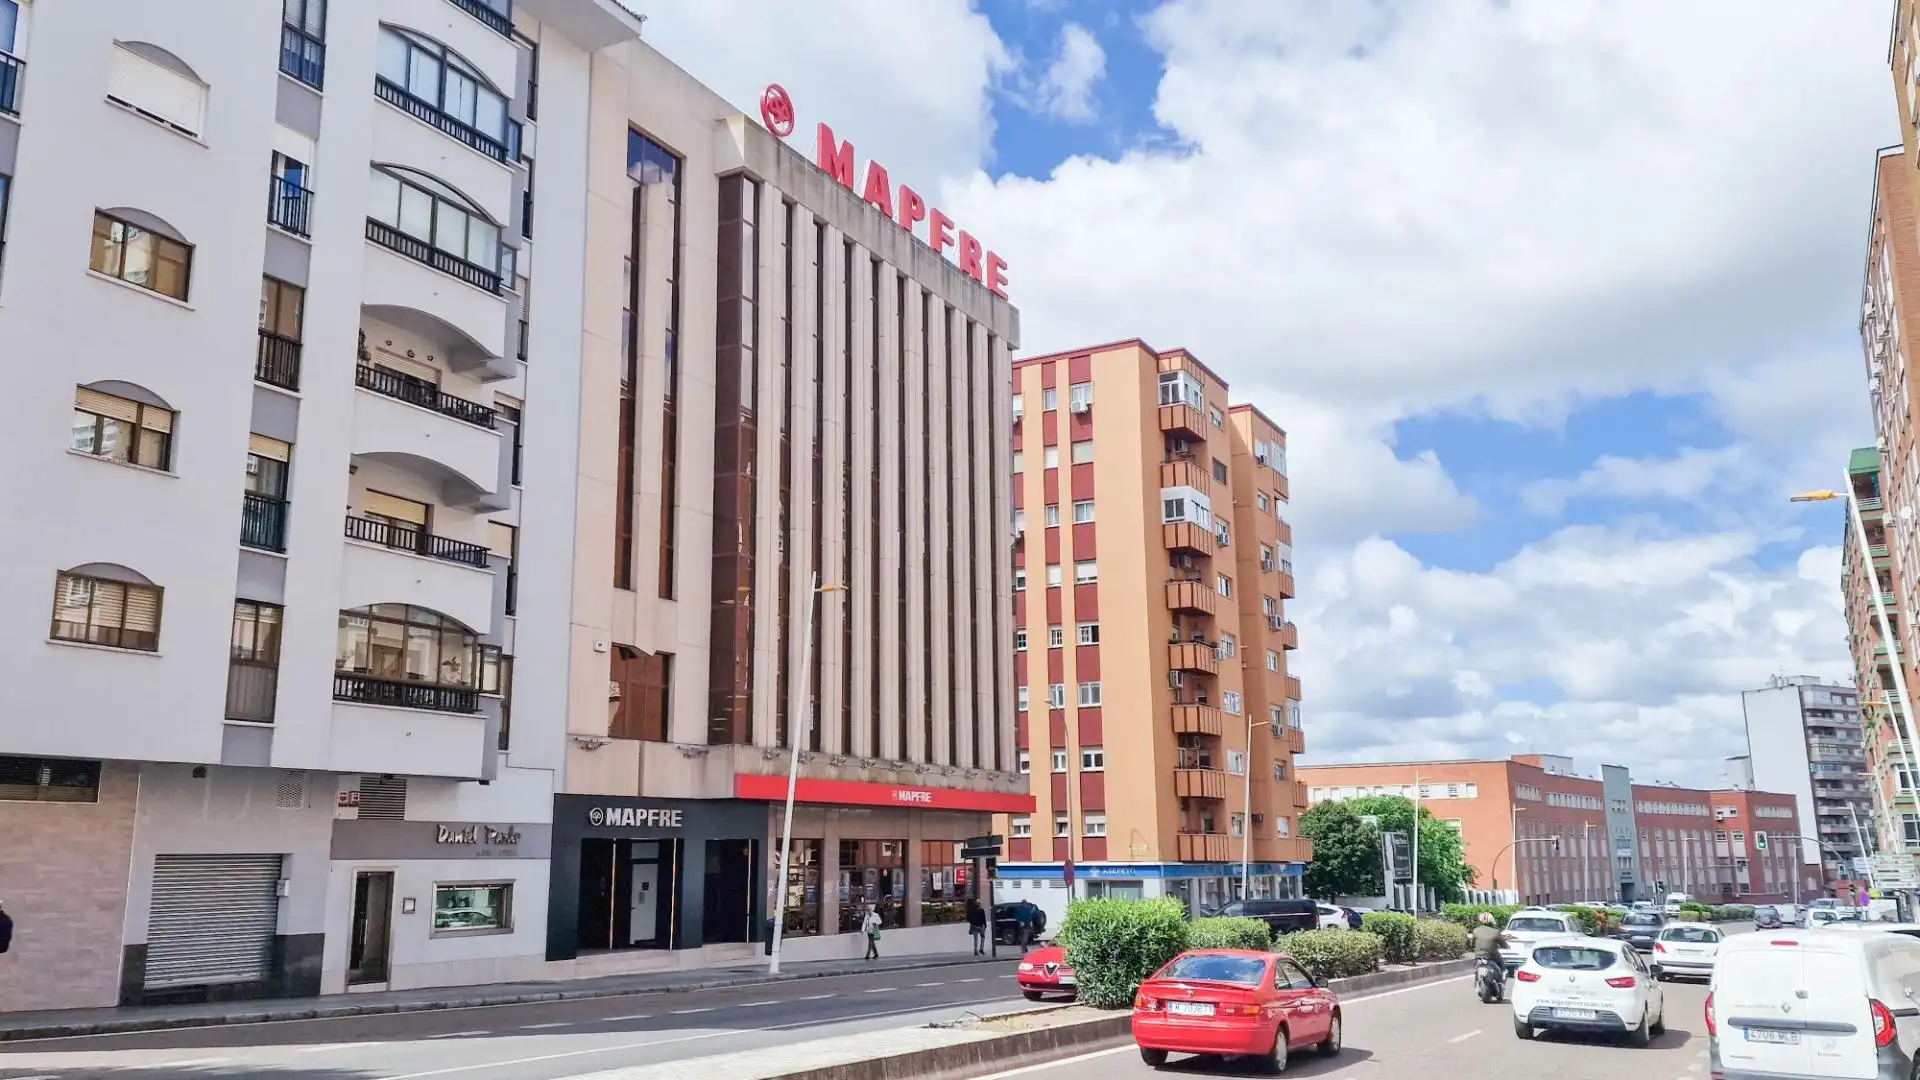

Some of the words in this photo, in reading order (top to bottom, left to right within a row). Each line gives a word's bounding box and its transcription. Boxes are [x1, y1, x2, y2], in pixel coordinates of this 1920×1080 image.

[816, 122, 1008, 301] MAPFRE
[898, 790, 932, 803] MAPFRE
[606, 807, 683, 828] MAPFRE
[436, 824, 478, 845] Daniel
